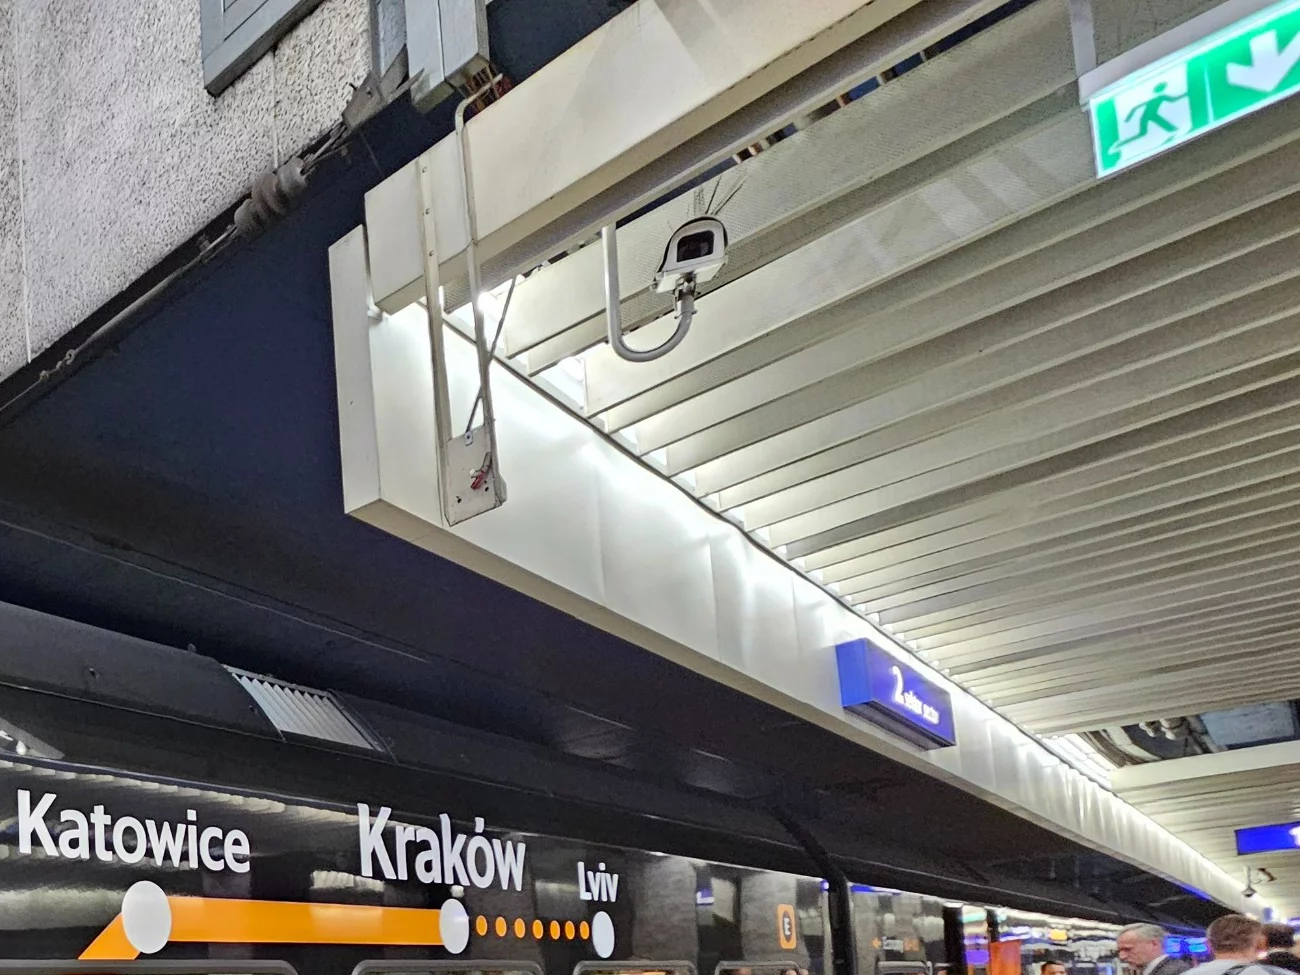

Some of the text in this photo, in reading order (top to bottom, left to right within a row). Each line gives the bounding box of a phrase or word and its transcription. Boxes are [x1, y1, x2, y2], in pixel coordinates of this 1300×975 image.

[17, 788, 252, 874] Katowice
[356, 803, 527, 891] Kraków
[576, 861, 620, 903] Lviv
